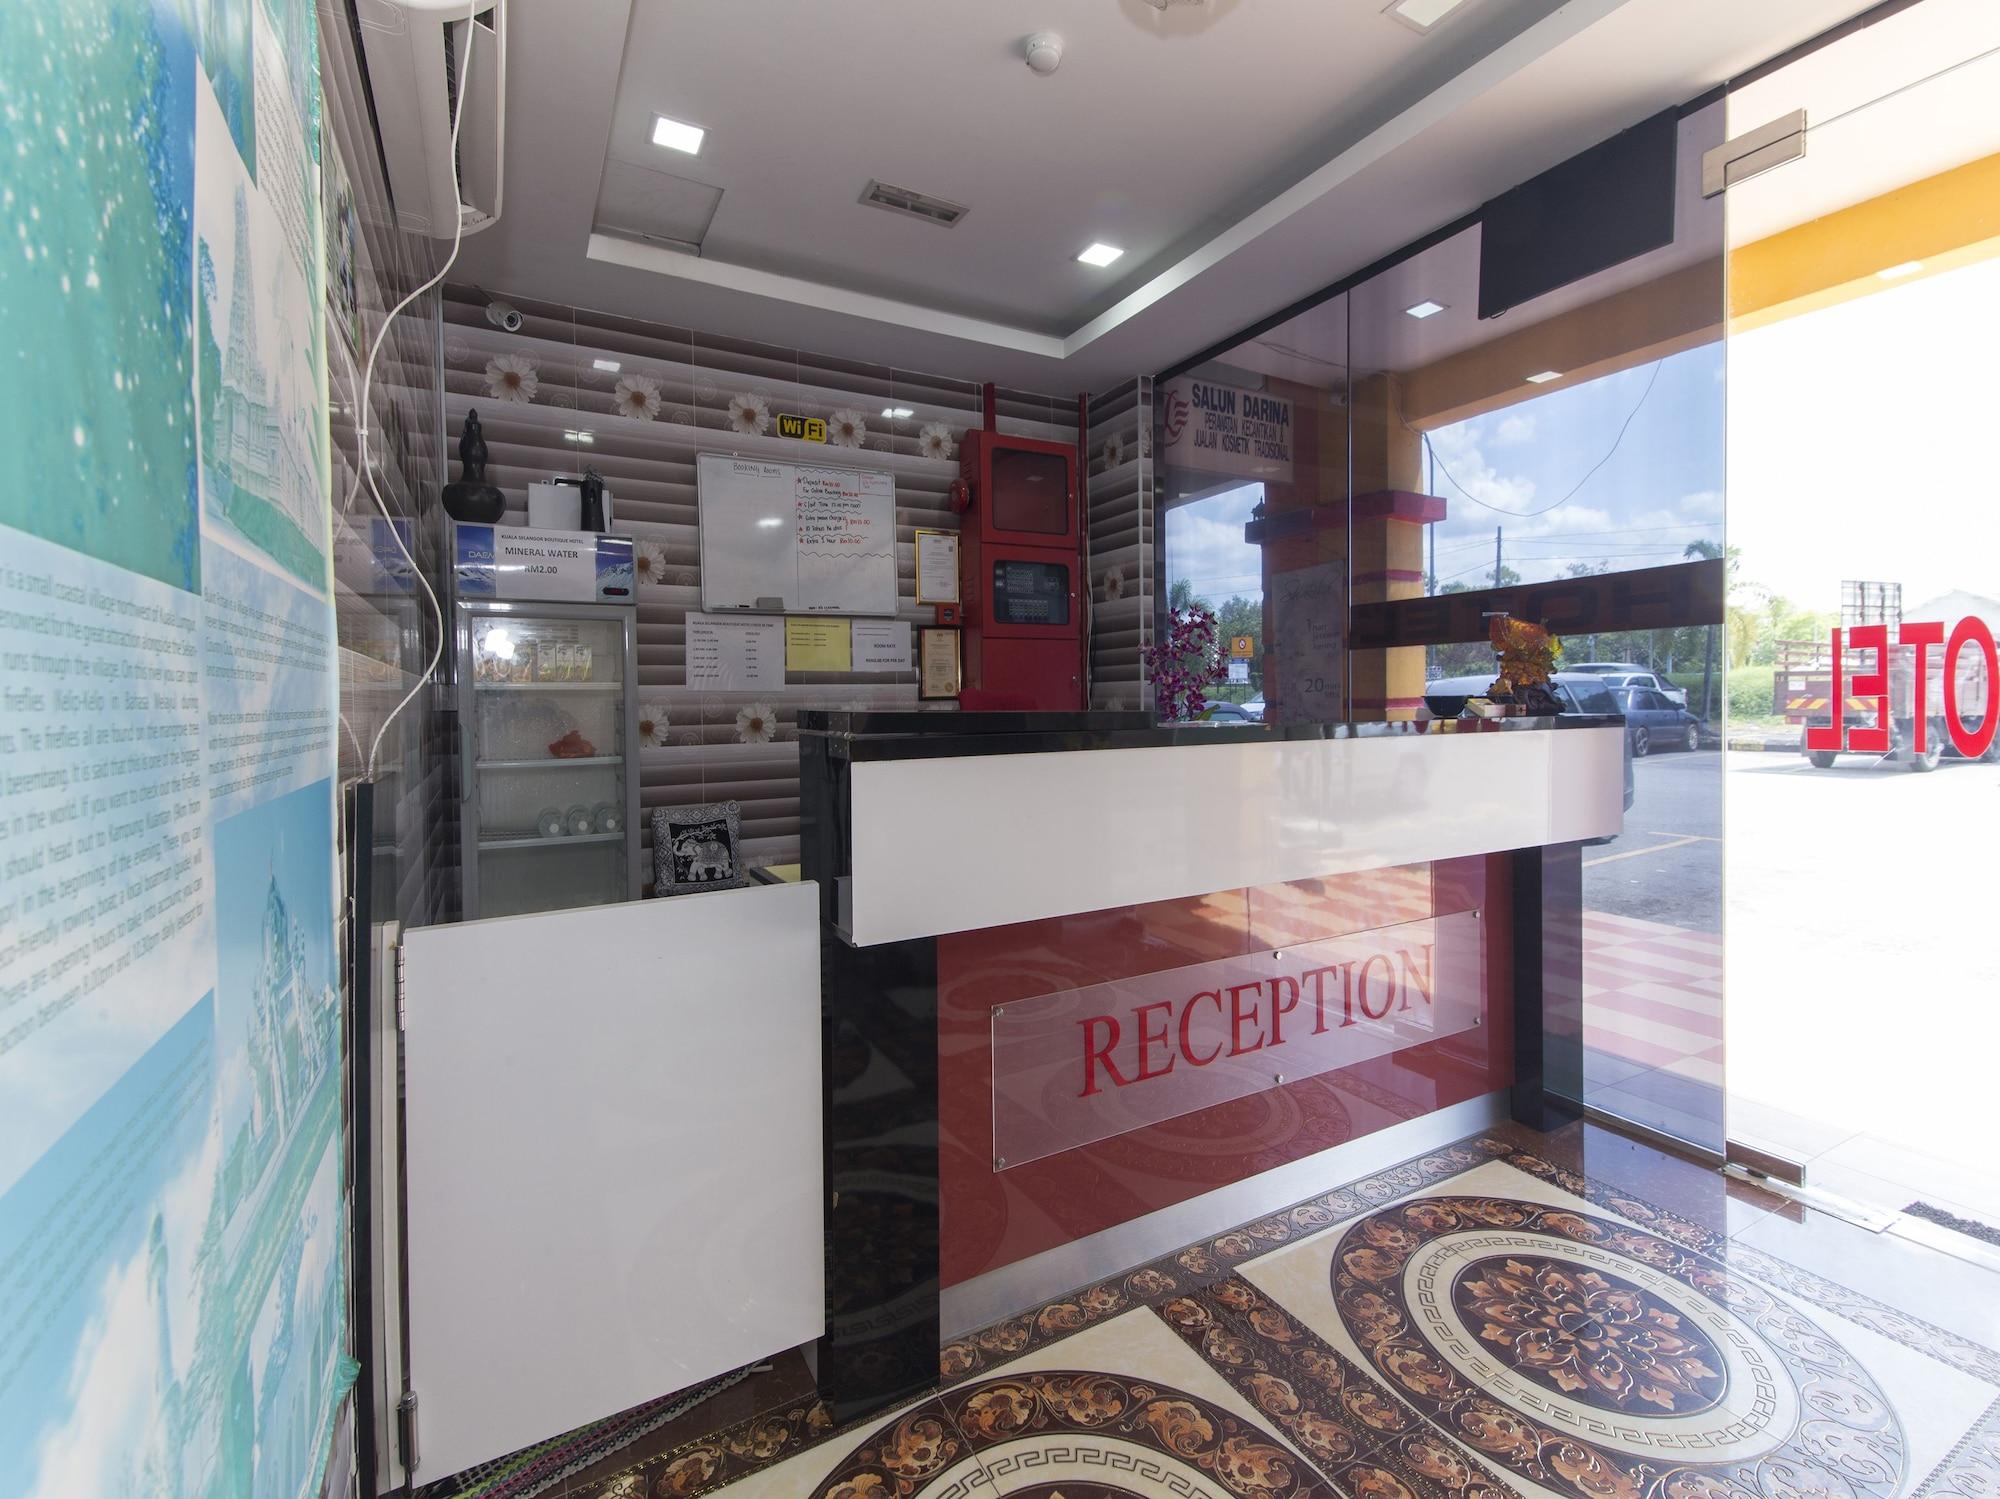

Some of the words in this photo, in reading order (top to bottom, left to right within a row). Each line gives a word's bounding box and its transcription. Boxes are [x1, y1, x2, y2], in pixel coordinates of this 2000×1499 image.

[1192, 383, 1236, 415] SALUN
[1243, 394, 1289, 427] DARINA
[1204, 412, 1238, 434] PERAWATAN
[1241, 420, 1277, 441] KECANTIKAN
[1194, 430, 1217, 449] JUALAN
[1221, 434, 1250, 455] KOSMETIK
[1254, 440, 1290, 462] TRADISIONAL
[505, 546, 546, 557] MINERAL
[547, 549, 578, 559] WATER
[1076, 943, 1436, 1099] RECEPTION
